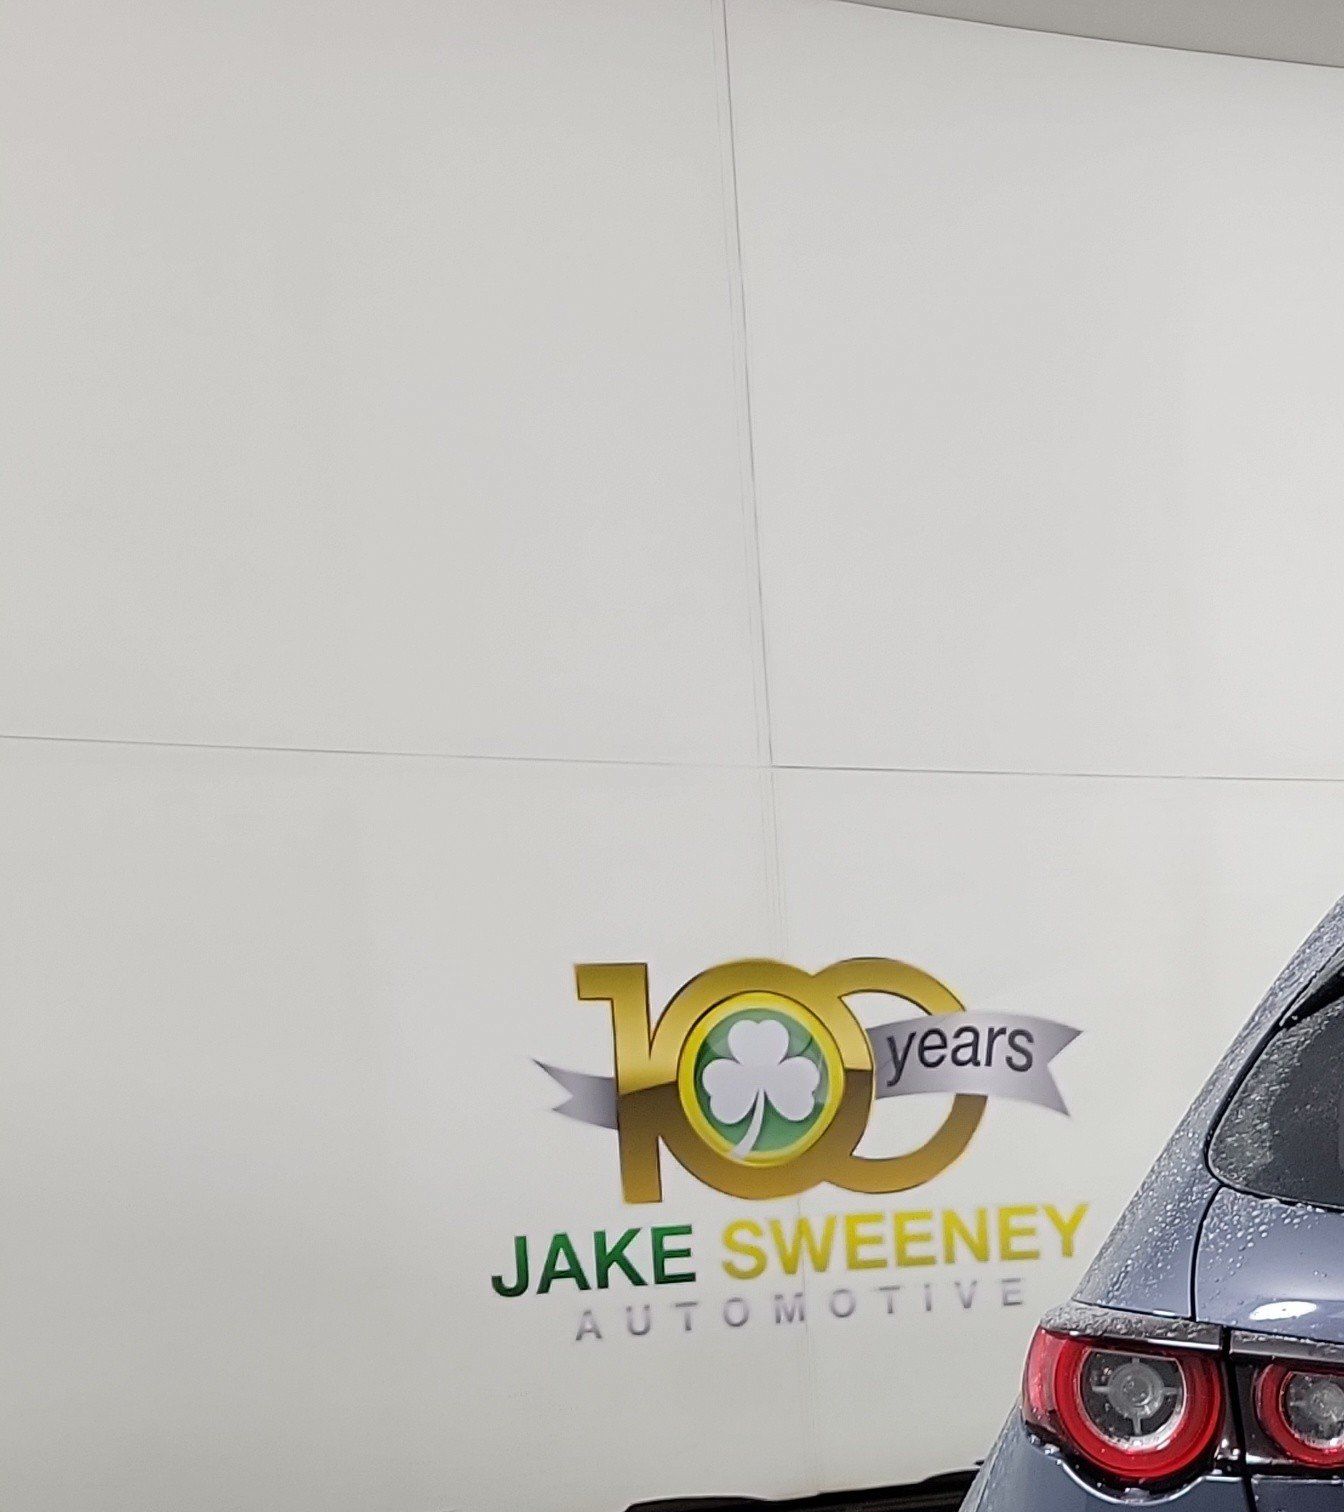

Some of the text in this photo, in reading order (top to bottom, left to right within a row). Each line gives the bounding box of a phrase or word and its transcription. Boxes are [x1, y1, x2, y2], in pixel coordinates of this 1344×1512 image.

[887, 1025, 1034, 1087] years
[490, 1203, 1090, 1298] JAKE SWEENEY
[575, 1278, 1024, 1341] AUTOMOTIVE
